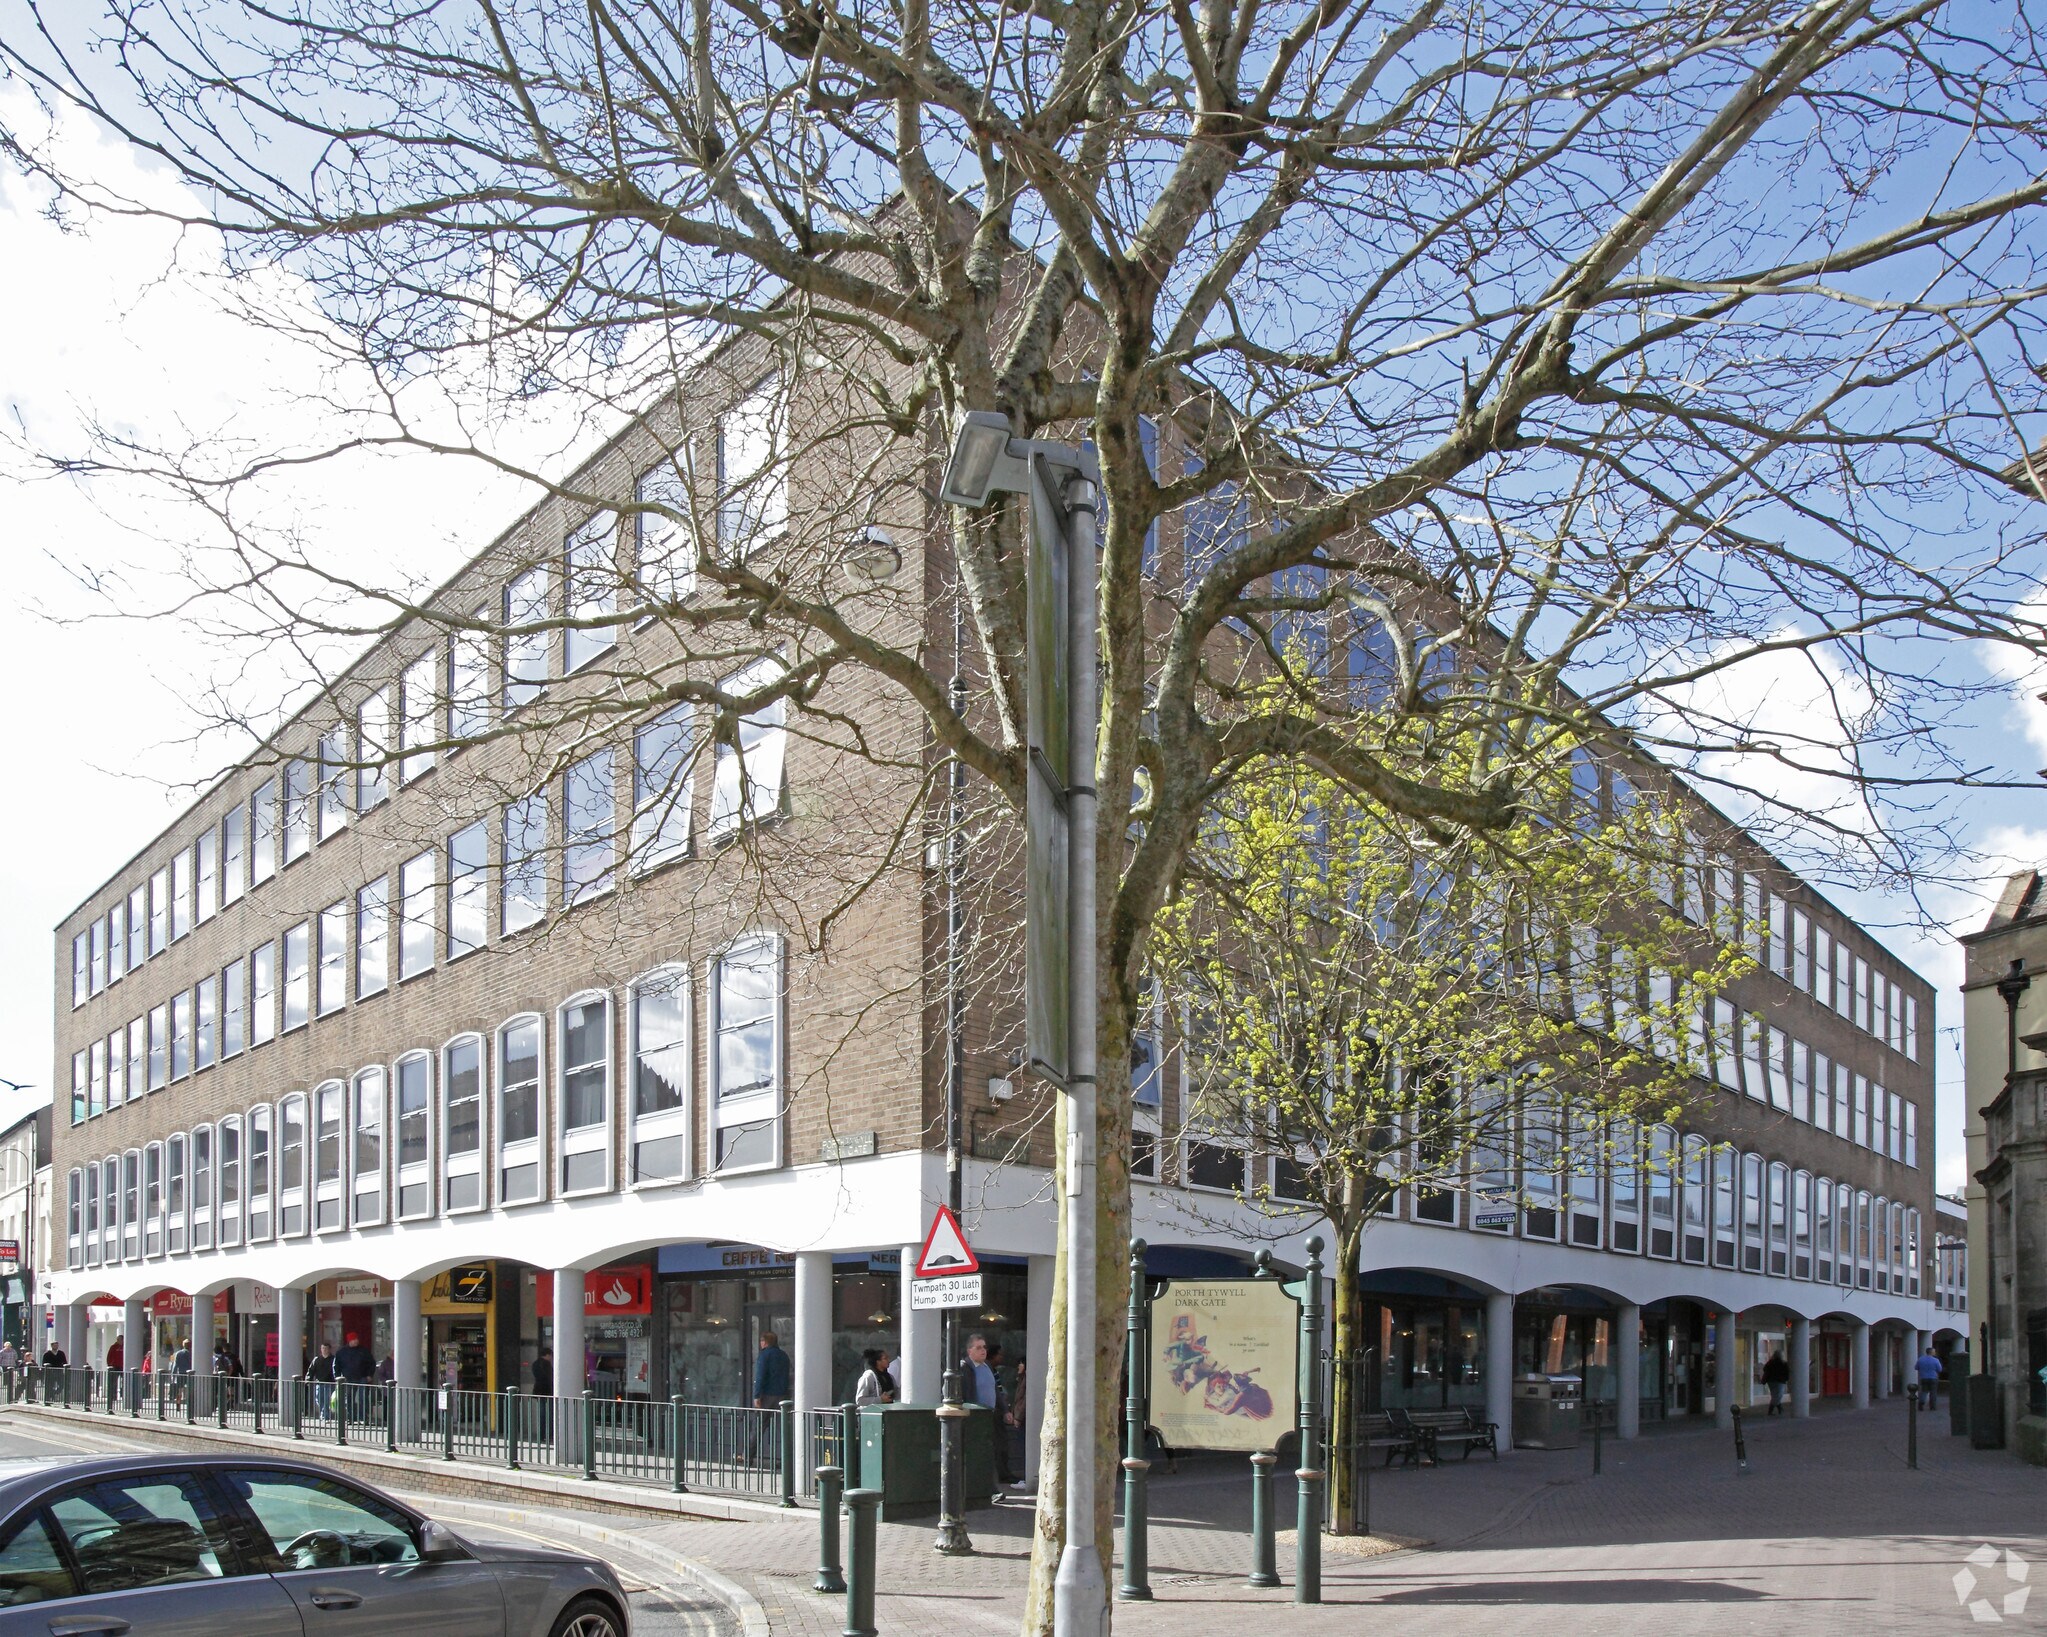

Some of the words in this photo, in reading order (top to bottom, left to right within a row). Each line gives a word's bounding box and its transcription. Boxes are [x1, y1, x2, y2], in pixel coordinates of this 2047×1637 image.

[871, 1253, 901, 1264] NER
[913, 1282, 946, 1293] Twmpath
[948, 1281, 960, 1290] 30
[962, 1280, 980, 1289] llath
[913, 1296, 936, 1305] Hump
[942, 1293, 954, 1303] 30
[956, 1292, 979, 1303] yards
[1175, 1289, 1205, 1297] PORTH
[170, 1293, 192, 1311] Rym
[1175, 1299, 1200, 1307] DARK
